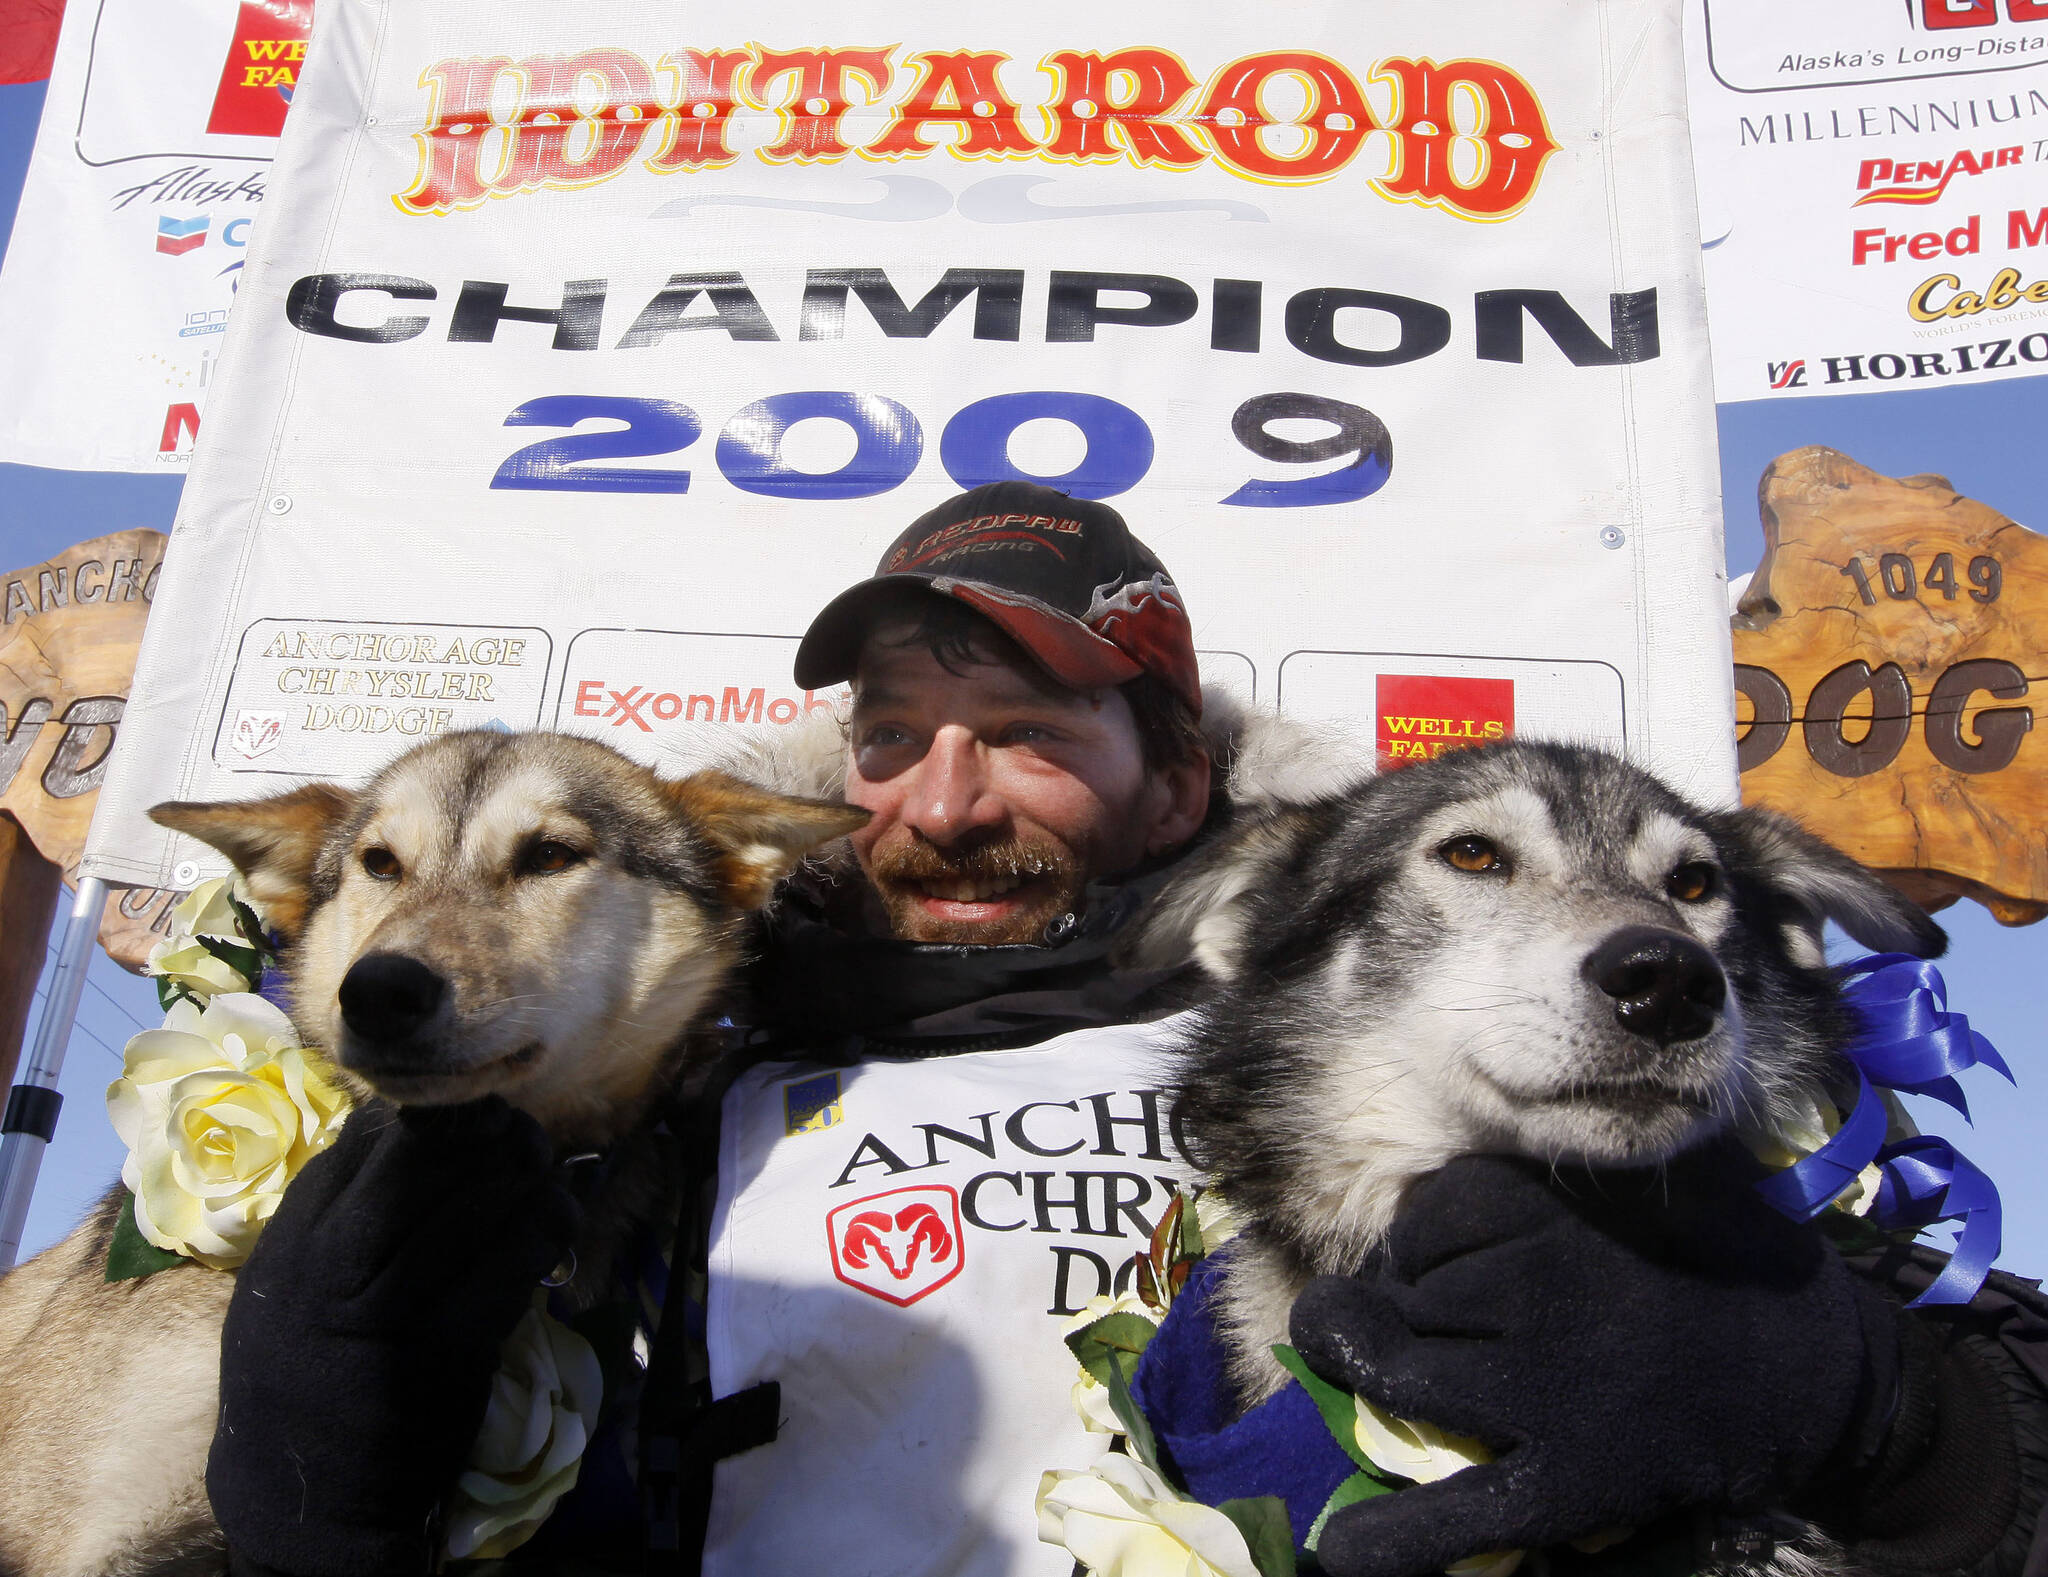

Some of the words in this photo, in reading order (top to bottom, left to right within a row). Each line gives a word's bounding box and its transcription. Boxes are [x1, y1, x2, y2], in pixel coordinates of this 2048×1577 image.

[1778, 49, 1885, 73] Alaska's
[391, 41, 1564, 224] IDITAROD
[1851, 215, 1981, 266] Fred
[285, 267, 1661, 367] CHAMPION
[1820, 332, 2048, 385] HORIZO
[489, 390, 1394, 508] 2009
[1840, 553, 2003, 607] 1049
[263, 630, 527, 667] ANCHORAGE
[276, 665, 496, 702] CHRYSLER
[573, 679, 850, 733] ExxonMob
[301, 703, 454, 736] DODGE
[1383, 716, 1505, 740] WELLS
